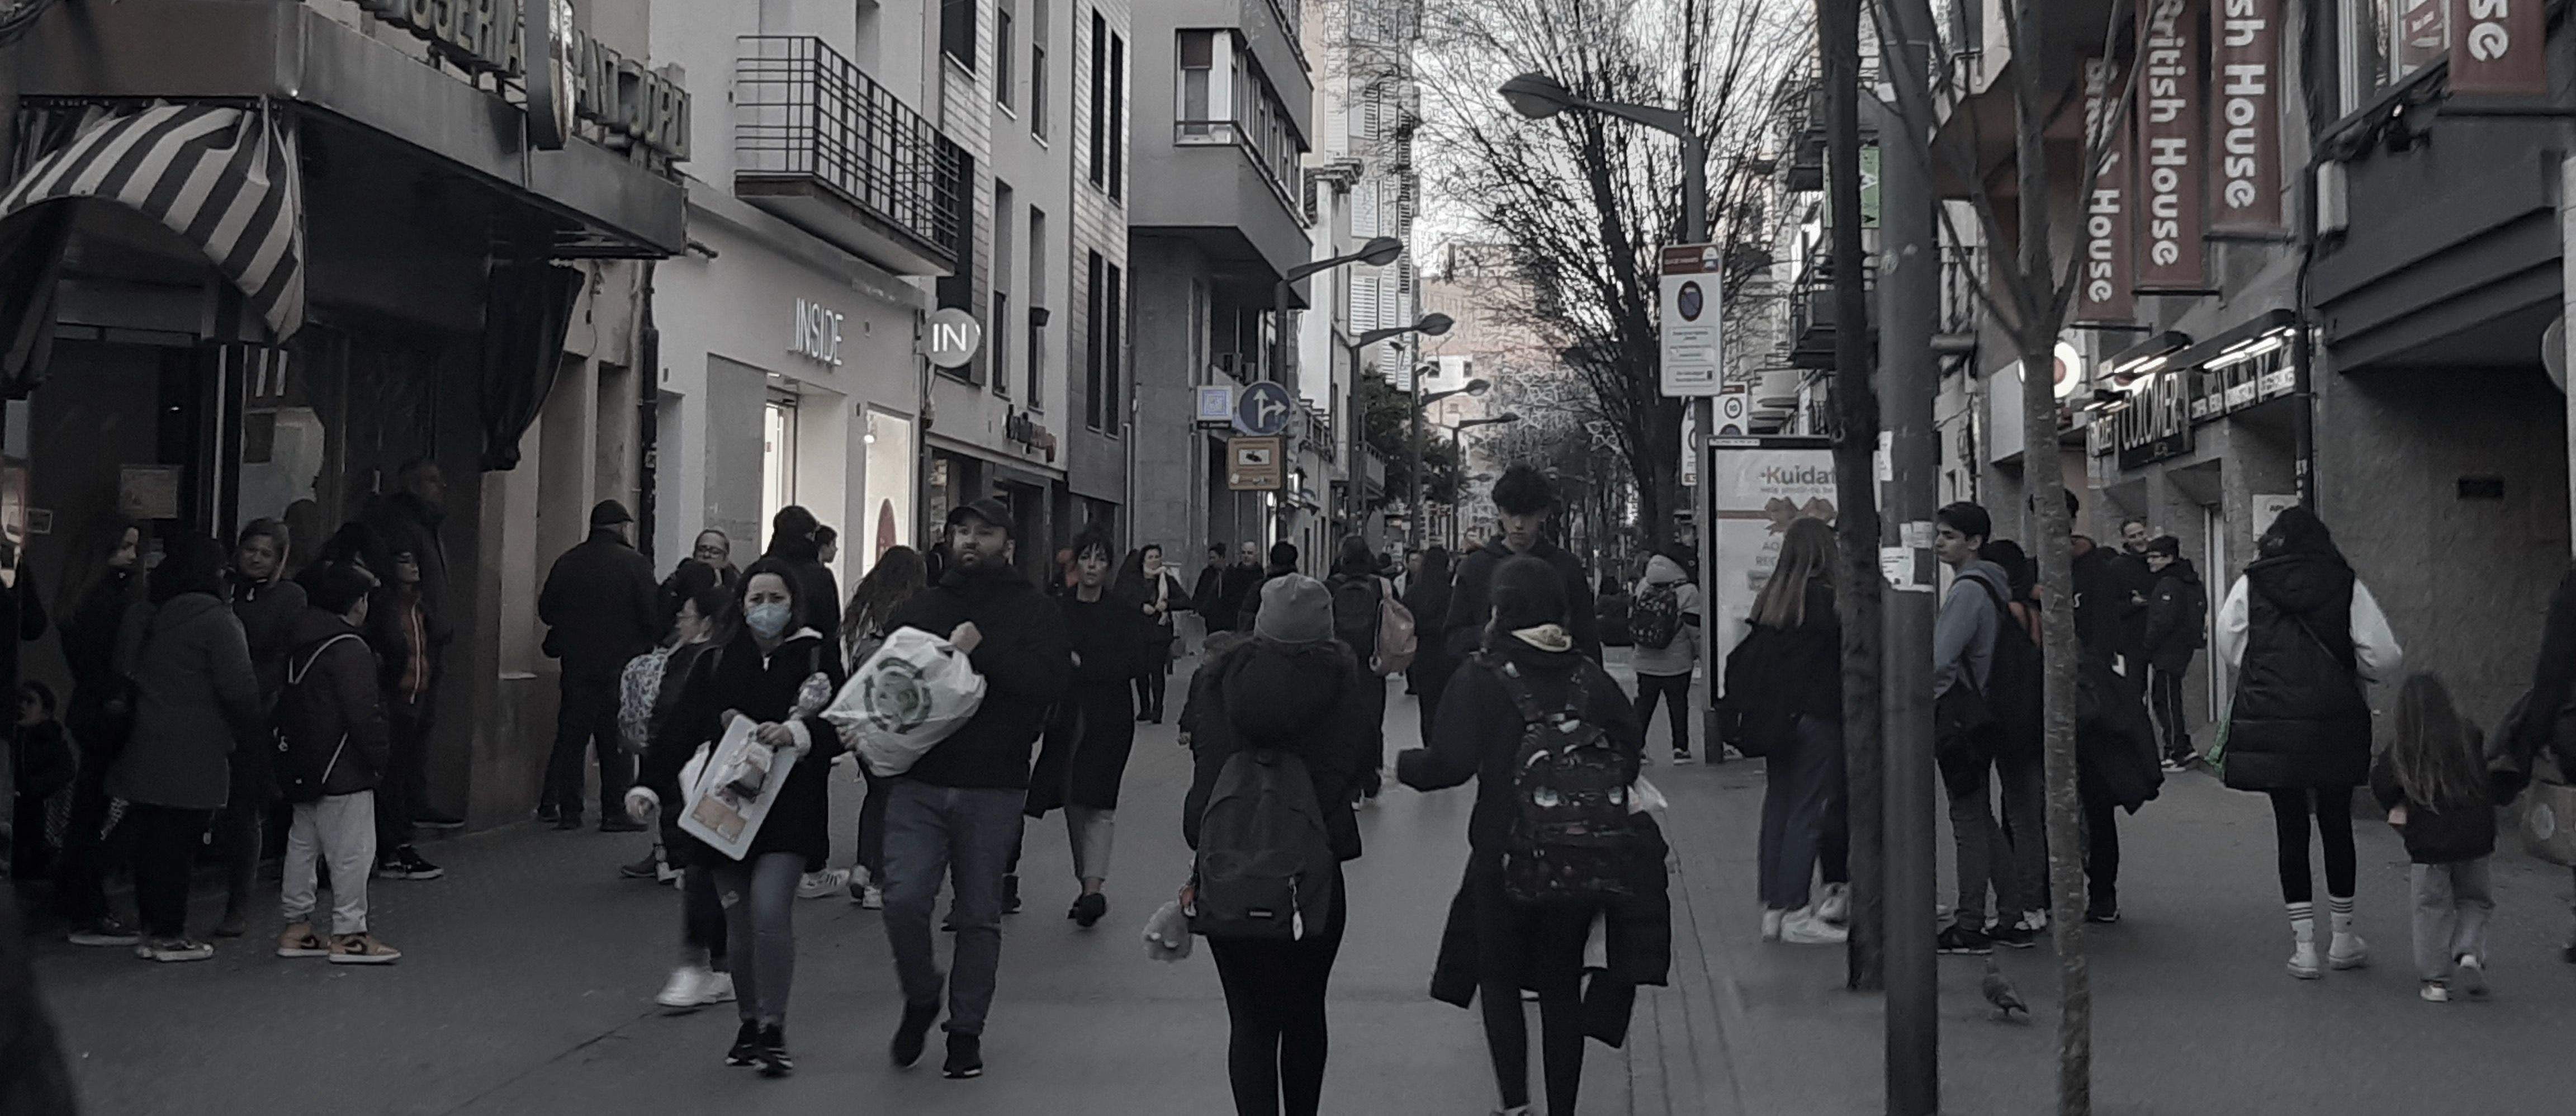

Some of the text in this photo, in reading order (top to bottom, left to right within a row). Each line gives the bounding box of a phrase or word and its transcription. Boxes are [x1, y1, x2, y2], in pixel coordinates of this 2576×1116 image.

[2224, 64, 2266, 209] House
[2087, 189, 2120, 303] House
[2151, 138, 2187, 266] House
[795, 297, 844, 366] INSIDE
[933, 323, 967, 352] IN
